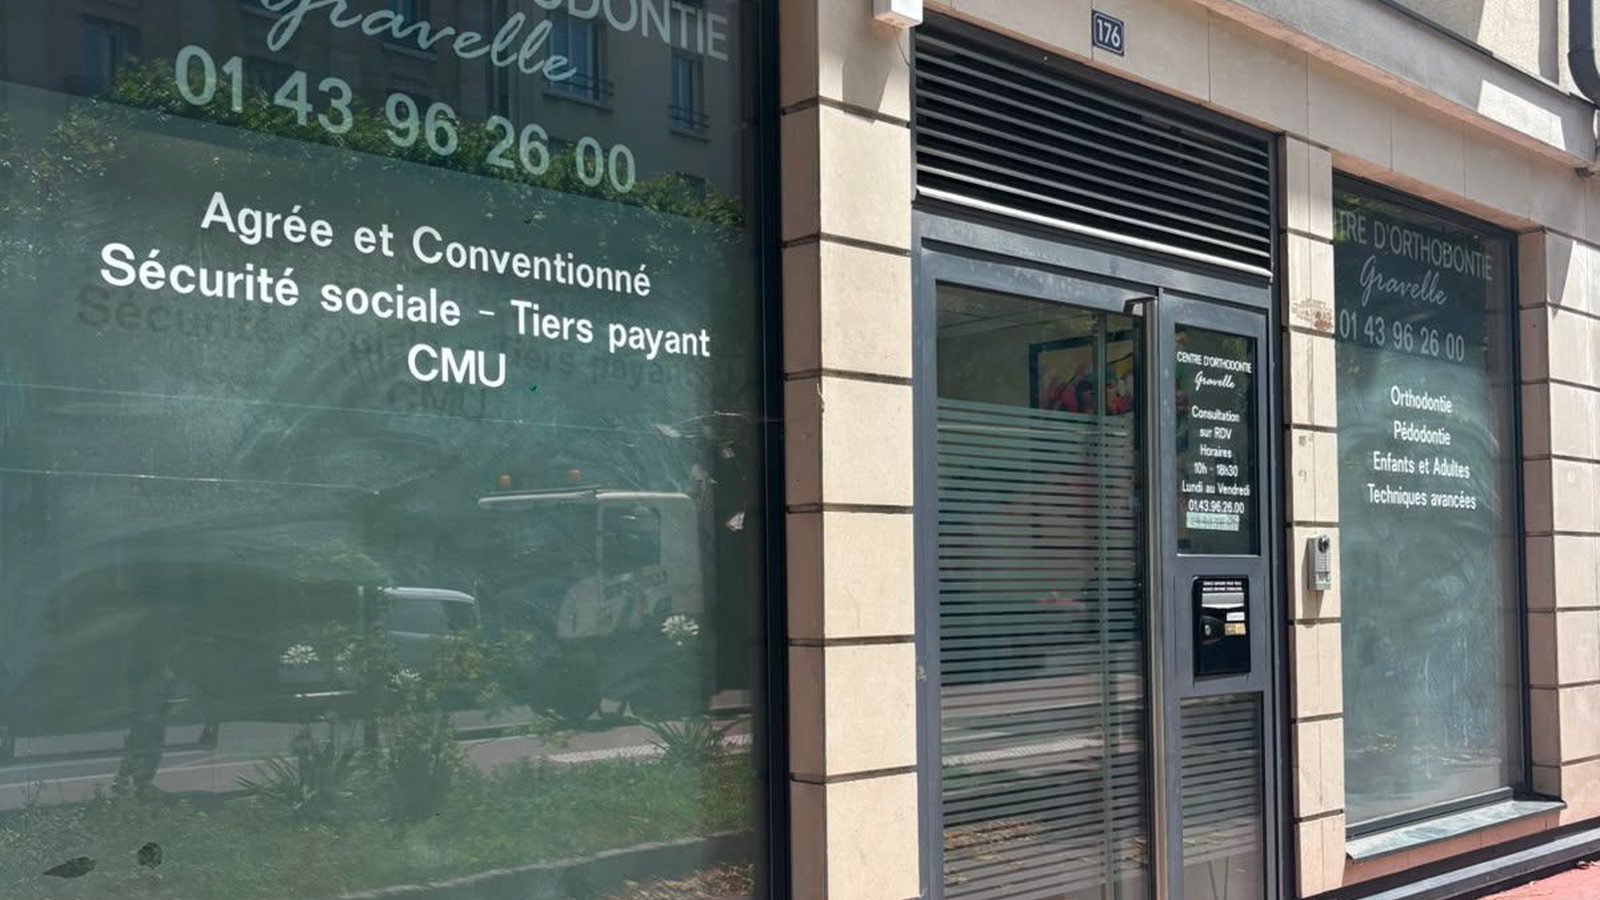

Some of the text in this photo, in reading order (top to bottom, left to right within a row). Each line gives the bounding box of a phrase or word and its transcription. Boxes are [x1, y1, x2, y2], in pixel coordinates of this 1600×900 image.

[1097, 18, 1121, 48] 176
[174, 45, 636, 194] 01 43 96 26 00
[201, 191, 652, 297] Agrée et Conventionné
[1334, 208, 1493, 281] TRE D'ORTHODONTIE
[1359, 255, 1448, 307] Gravelle
[100, 242, 300, 307] Sécurité
[320, 283, 461, 327] sociale
[510, 298, 594, 344] Tiers
[608, 323, 711, 361] payant
[1339, 308, 1465, 362] 01 43 96 26 00
[407, 342, 507, 388] CMU
[1176, 350, 1253, 374] CENTRE D'ORTHODONTIE
[1194, 370, 1236, 391] Gravelle
[1391, 385, 1452, 413] Orthodontie
[1191, 404, 1240, 423] Consultation
[1199, 426, 1233, 440] sur RDV
[1393, 420, 1451, 446] Pédodontie
[1200, 444, 1232, 459] Horaires
[1373, 451, 1471, 479] Enfants et Adultes
[1194, 462, 1208, 475] 10h
[1216, 464, 1239, 477] 18h30
[1182, 480, 1251, 497] Lundi au Vendredi
[1367, 483, 1477, 510] Techniques avancées
[1188, 499, 1245, 514] 01.43.96.26.00
